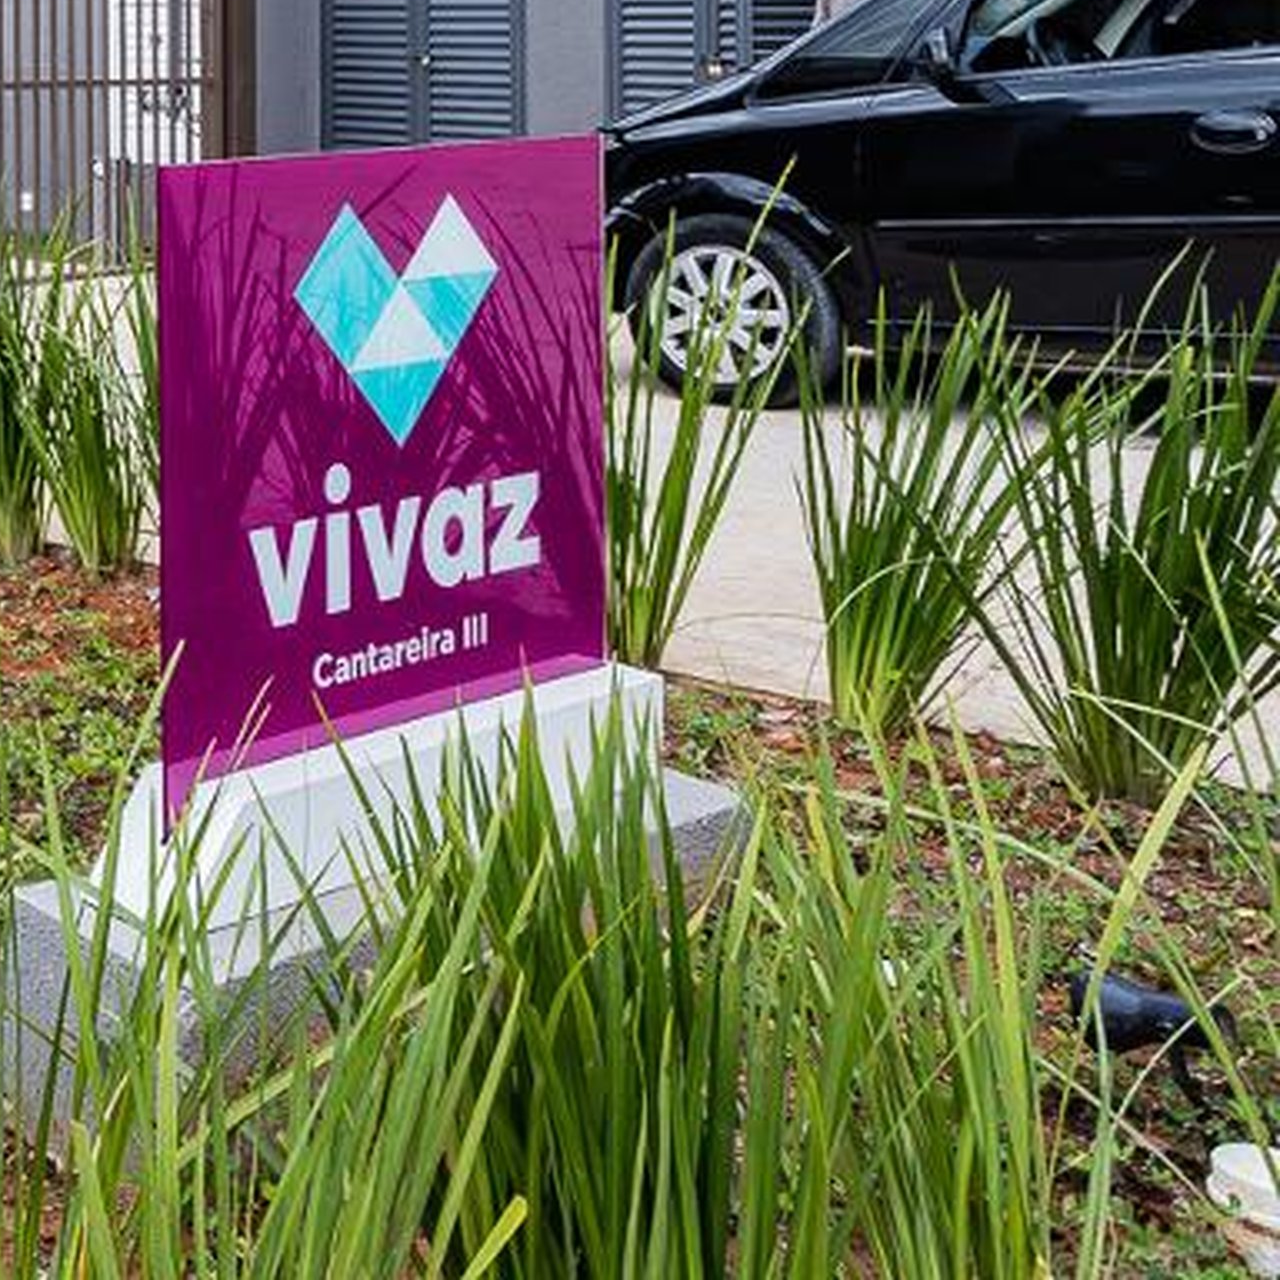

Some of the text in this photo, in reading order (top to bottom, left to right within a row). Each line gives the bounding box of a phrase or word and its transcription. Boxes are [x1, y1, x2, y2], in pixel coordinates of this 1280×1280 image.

[248, 463, 541, 628] vivaz
[312, 612, 488, 688] Cantareira III
